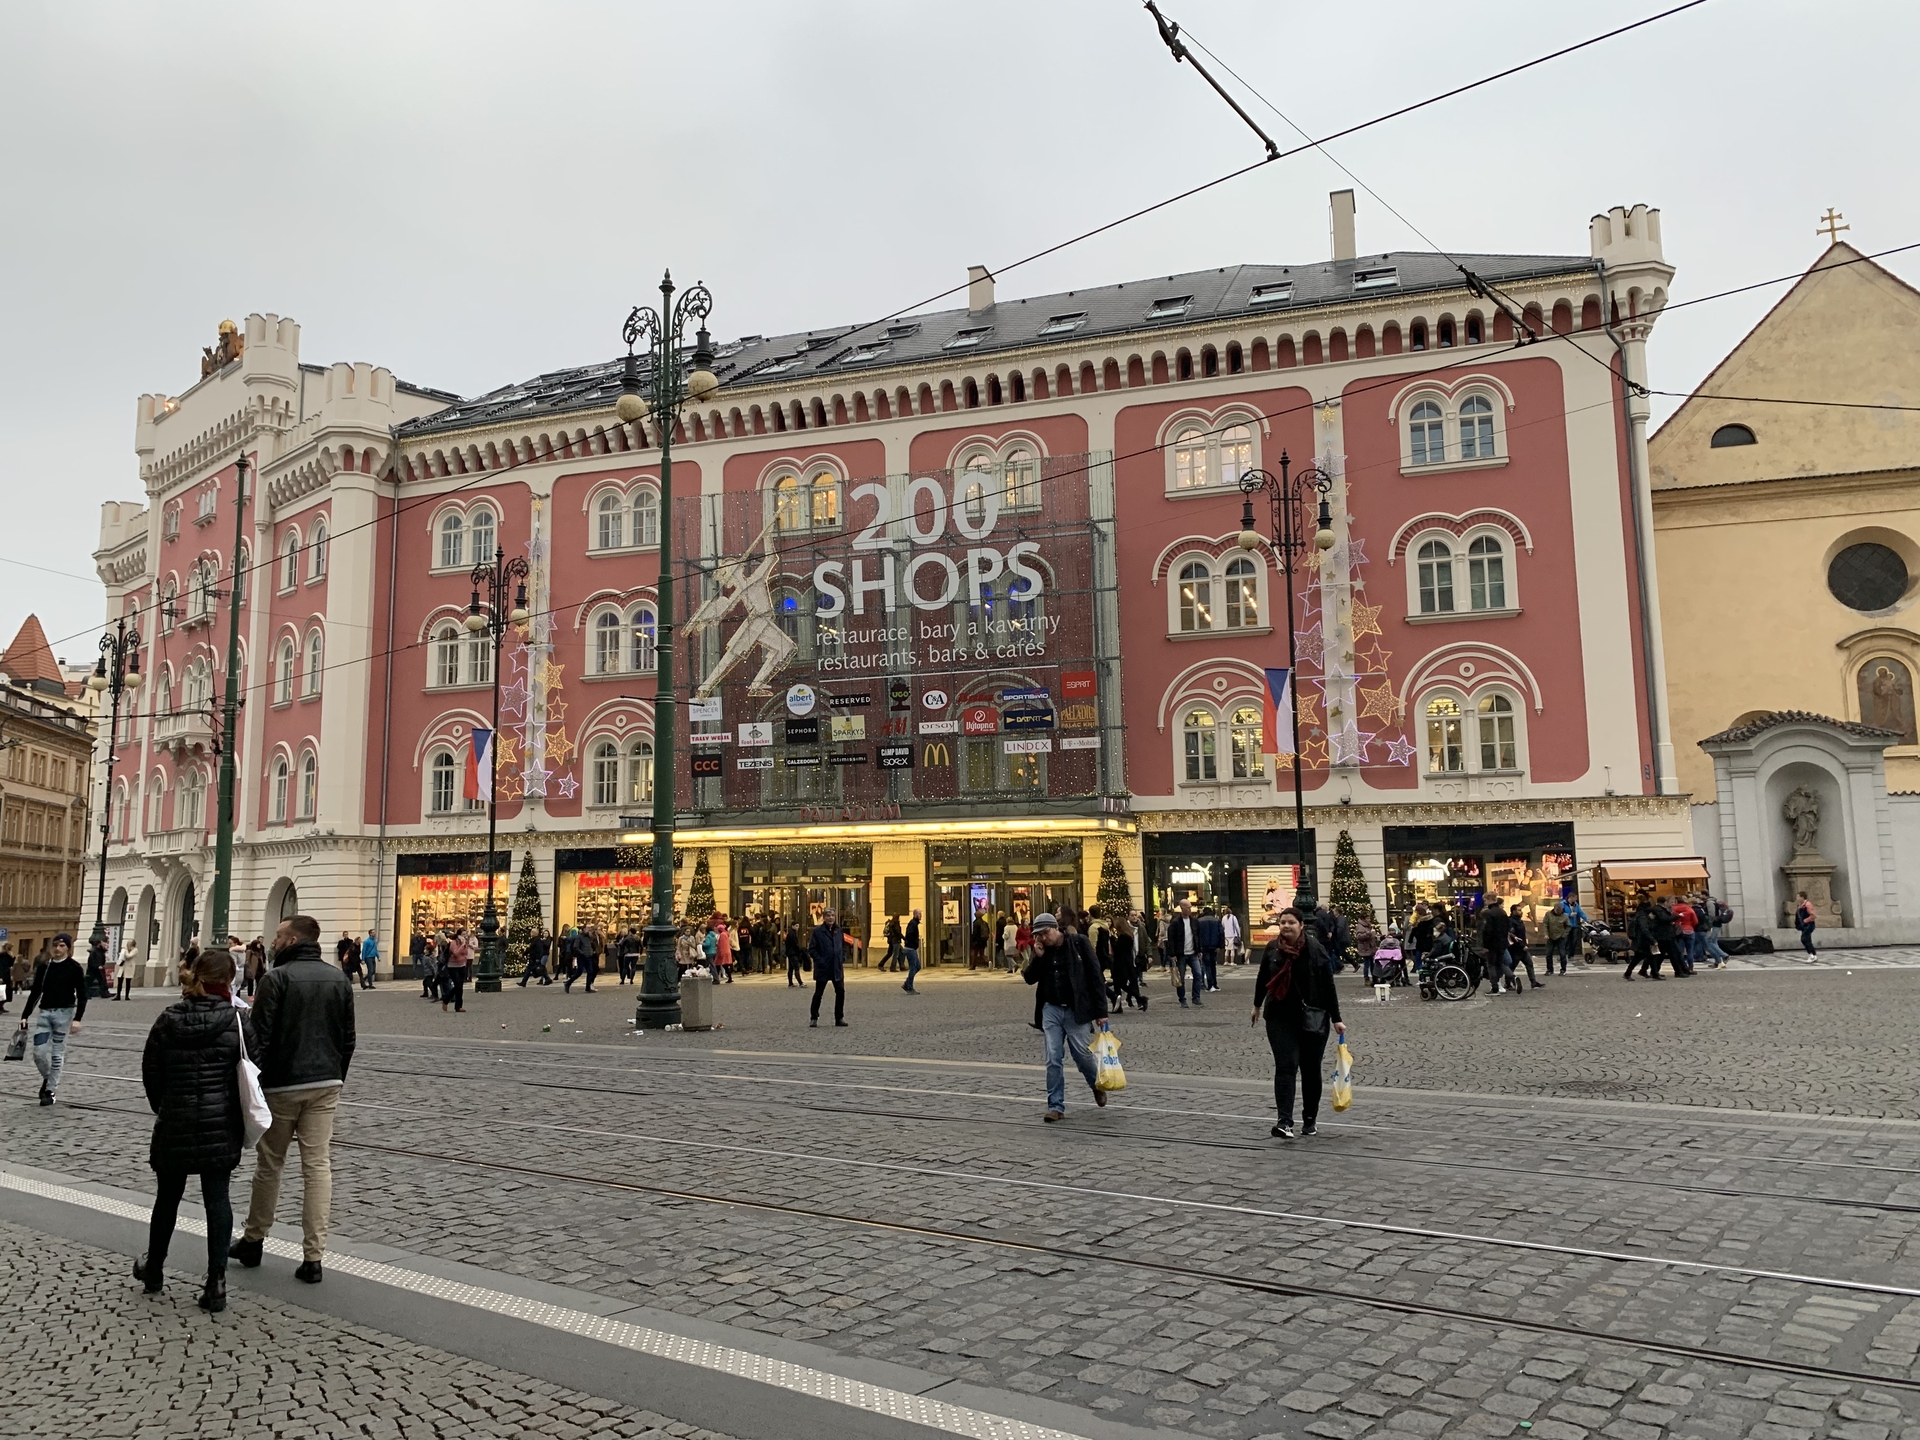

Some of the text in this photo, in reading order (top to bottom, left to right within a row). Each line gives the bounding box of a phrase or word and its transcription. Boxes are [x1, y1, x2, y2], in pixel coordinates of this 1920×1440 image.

[849, 471, 1000, 551] 200
[813, 541, 1043, 619] SHOPS
[816, 614, 1061, 646] restaurace, bary a kavárny
[818, 638, 1045, 671] restaurants, bars & cafés
[1066, 680, 1091, 689] ESPRIT
[789, 693, 812, 702] albert
[829, 697, 871, 705] RESERVED
[925, 693, 945, 706] C&A
[692, 706, 719, 714] SPENCER
[787, 727, 816, 735] SEPHORA
[833, 728, 865, 737] SPARKYS
[921, 722, 953, 732] orsay
[880, 747, 909, 756] CAMP DAVID
[1006, 741, 1049, 752] LINDEX
[694, 760, 719, 771] CCC
[786, 757, 821, 765] CALZEDONIA
[799, 803, 902, 822] PALLADIUM
[579, 872, 612, 889] Foot
[1407, 868, 1445, 882] PUMA
[420, 876, 449, 891] Foot
